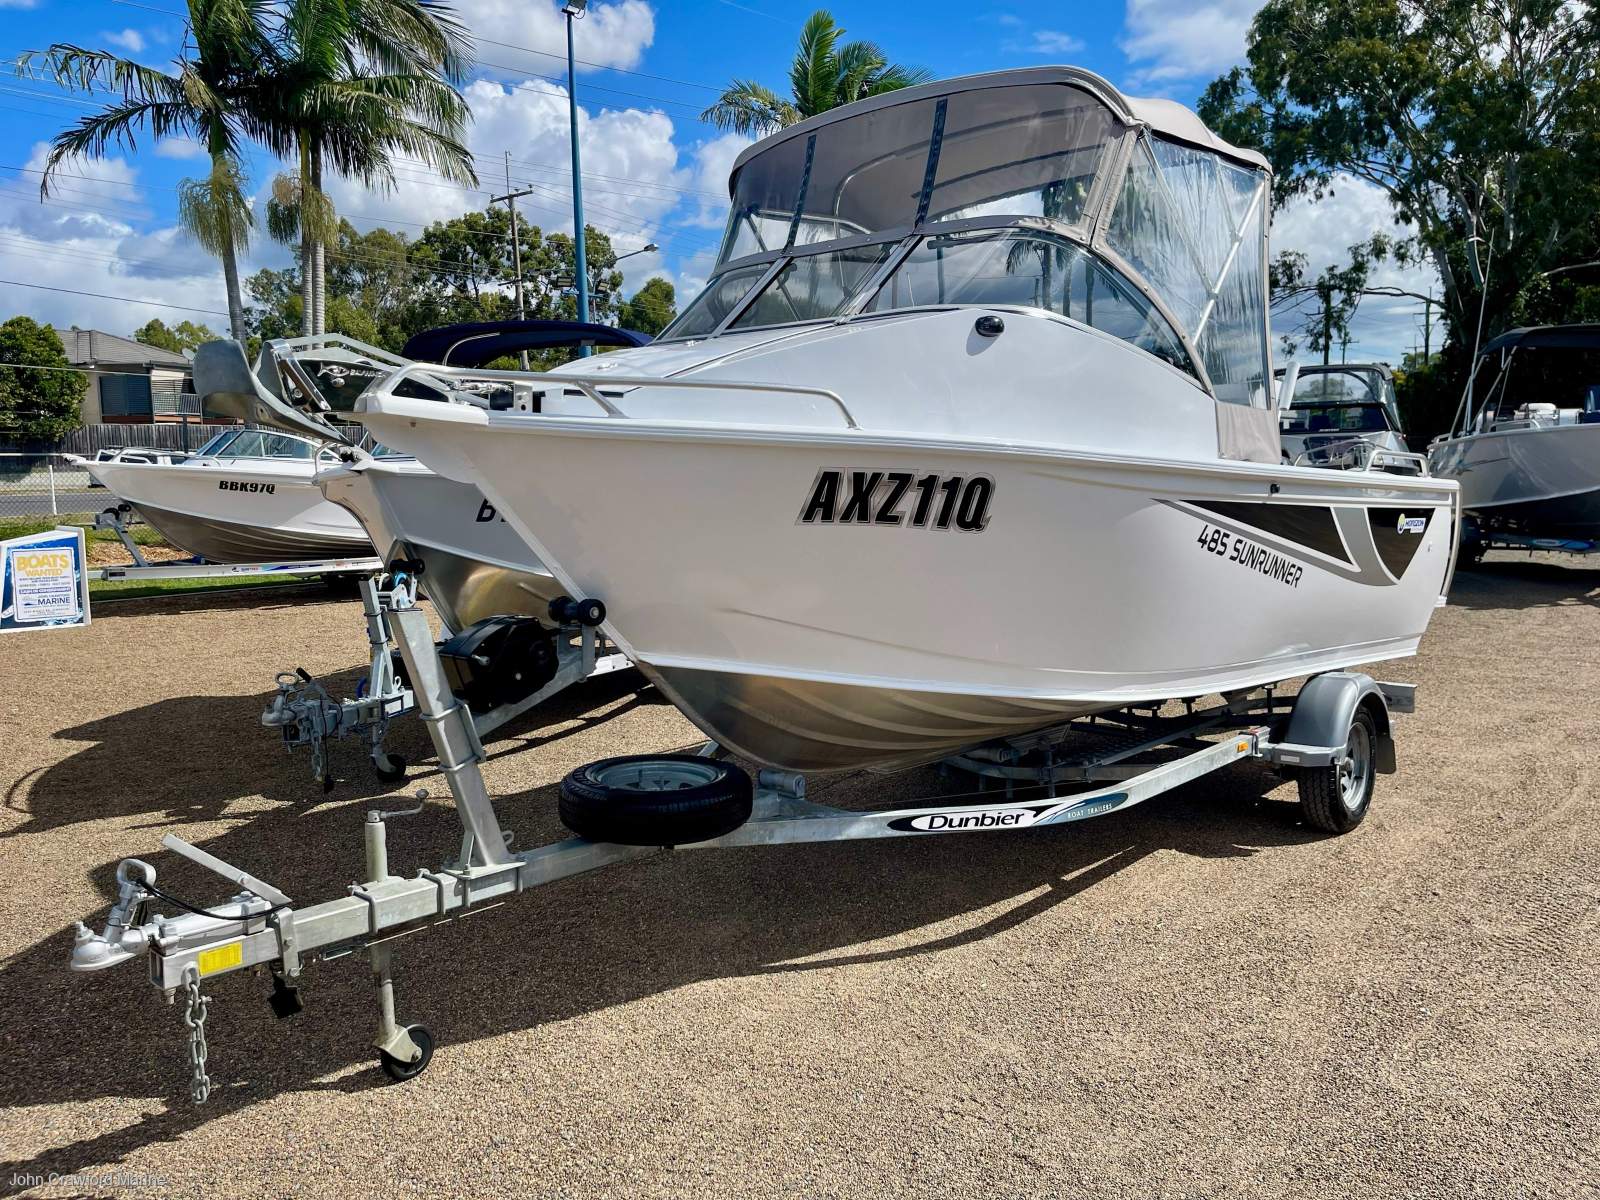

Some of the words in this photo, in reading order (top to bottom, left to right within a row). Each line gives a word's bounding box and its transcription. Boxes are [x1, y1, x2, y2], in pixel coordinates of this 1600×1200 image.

[219, 480, 276, 494] BBK97Q
[800, 470, 993, 533] AXZ11Q
[16, 554, 69, 571] BOATS
[1197, 524, 1231, 557] 485
[1229, 538, 1303, 589] SUNRUNNER
[37, 597, 71, 605] MARINE
[927, 811, 1024, 830] Dunbier
[1067, 809, 1084, 819] BOAT
[1087, 803, 1112, 815] TRAILERS
